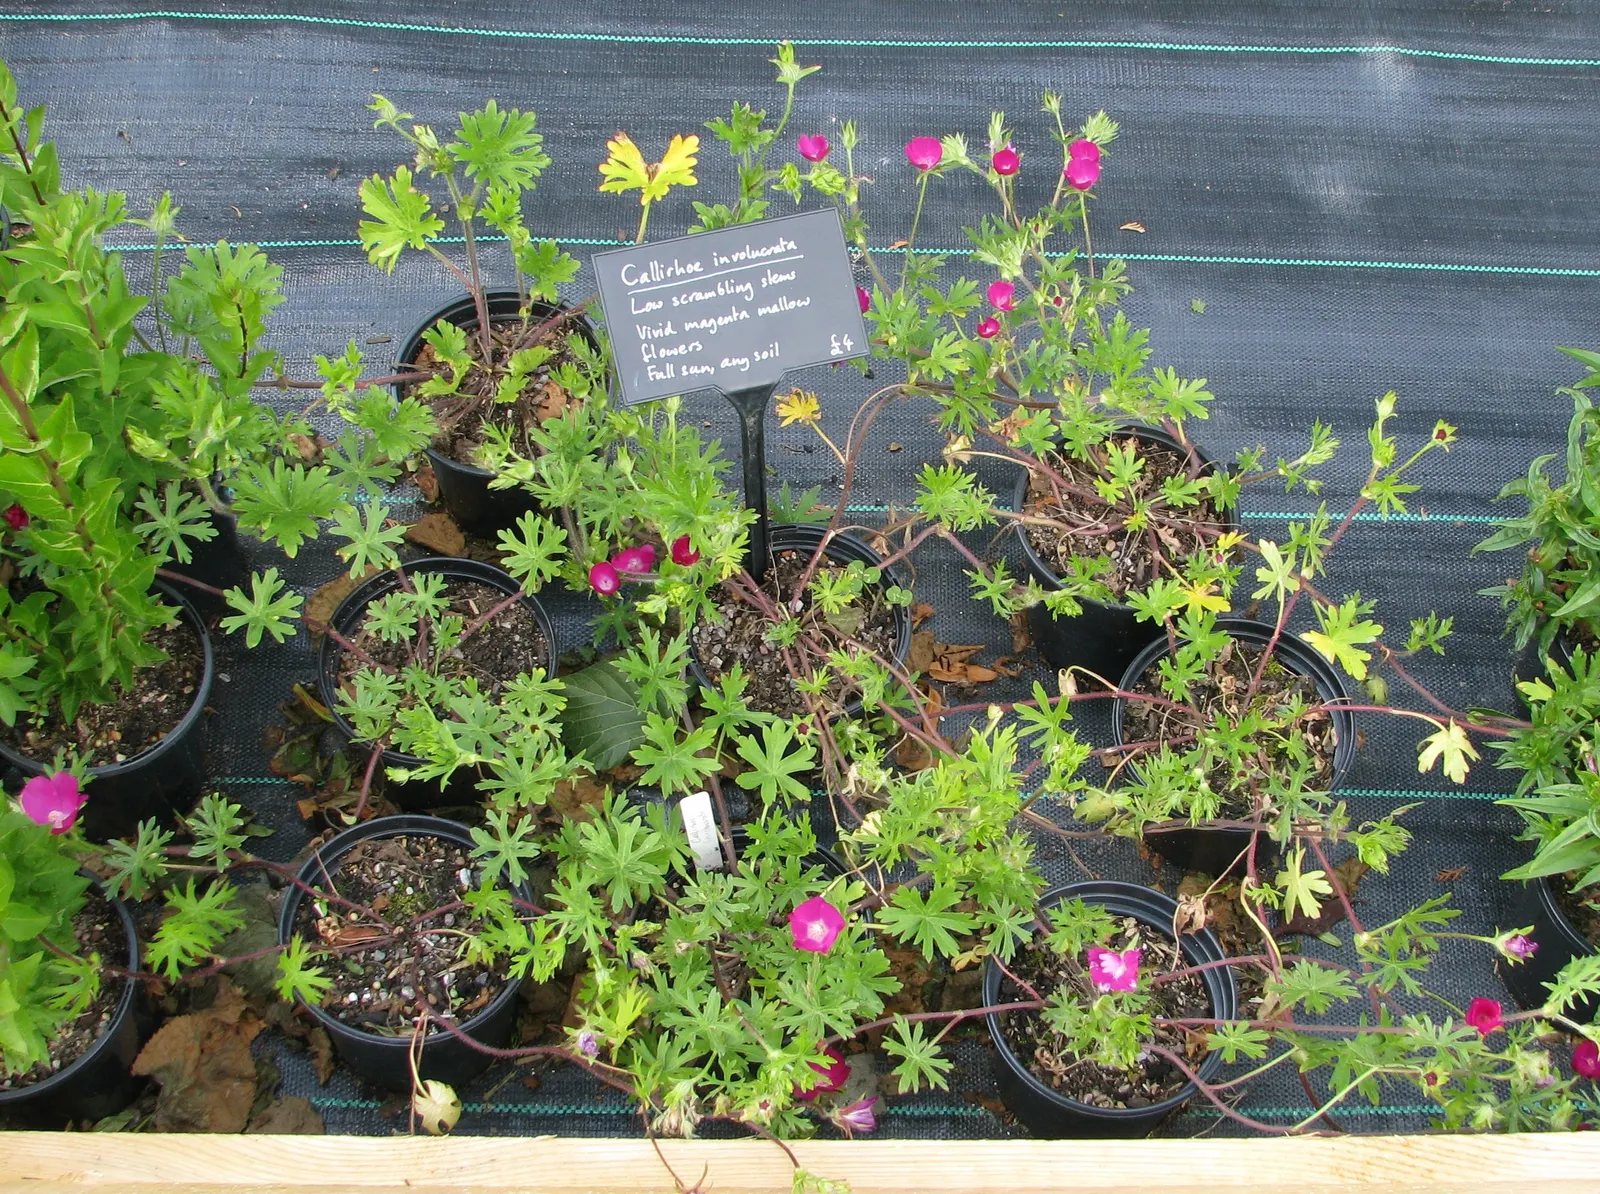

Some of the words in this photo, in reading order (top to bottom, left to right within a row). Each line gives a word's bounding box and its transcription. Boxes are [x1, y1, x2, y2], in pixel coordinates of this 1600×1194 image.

[621, 258, 704, 286] Callirhoe
[713, 237, 797, 266] involucrata
[631, 297, 664, 315] Low
[672, 279, 754, 307] scrambling
[761, 269, 797, 288] stems
[636, 320, 677, 341] Vivid
[684, 306, 750, 335] magenta
[757, 297, 811, 317] mallow
[641, 340, 703, 363] flowers
[647, 362, 675, 382] Full
[681, 363, 715, 376] sun,
[720, 355, 750, 371] any
[754, 342, 780, 362] soil
[830, 333, 854, 356] £4
